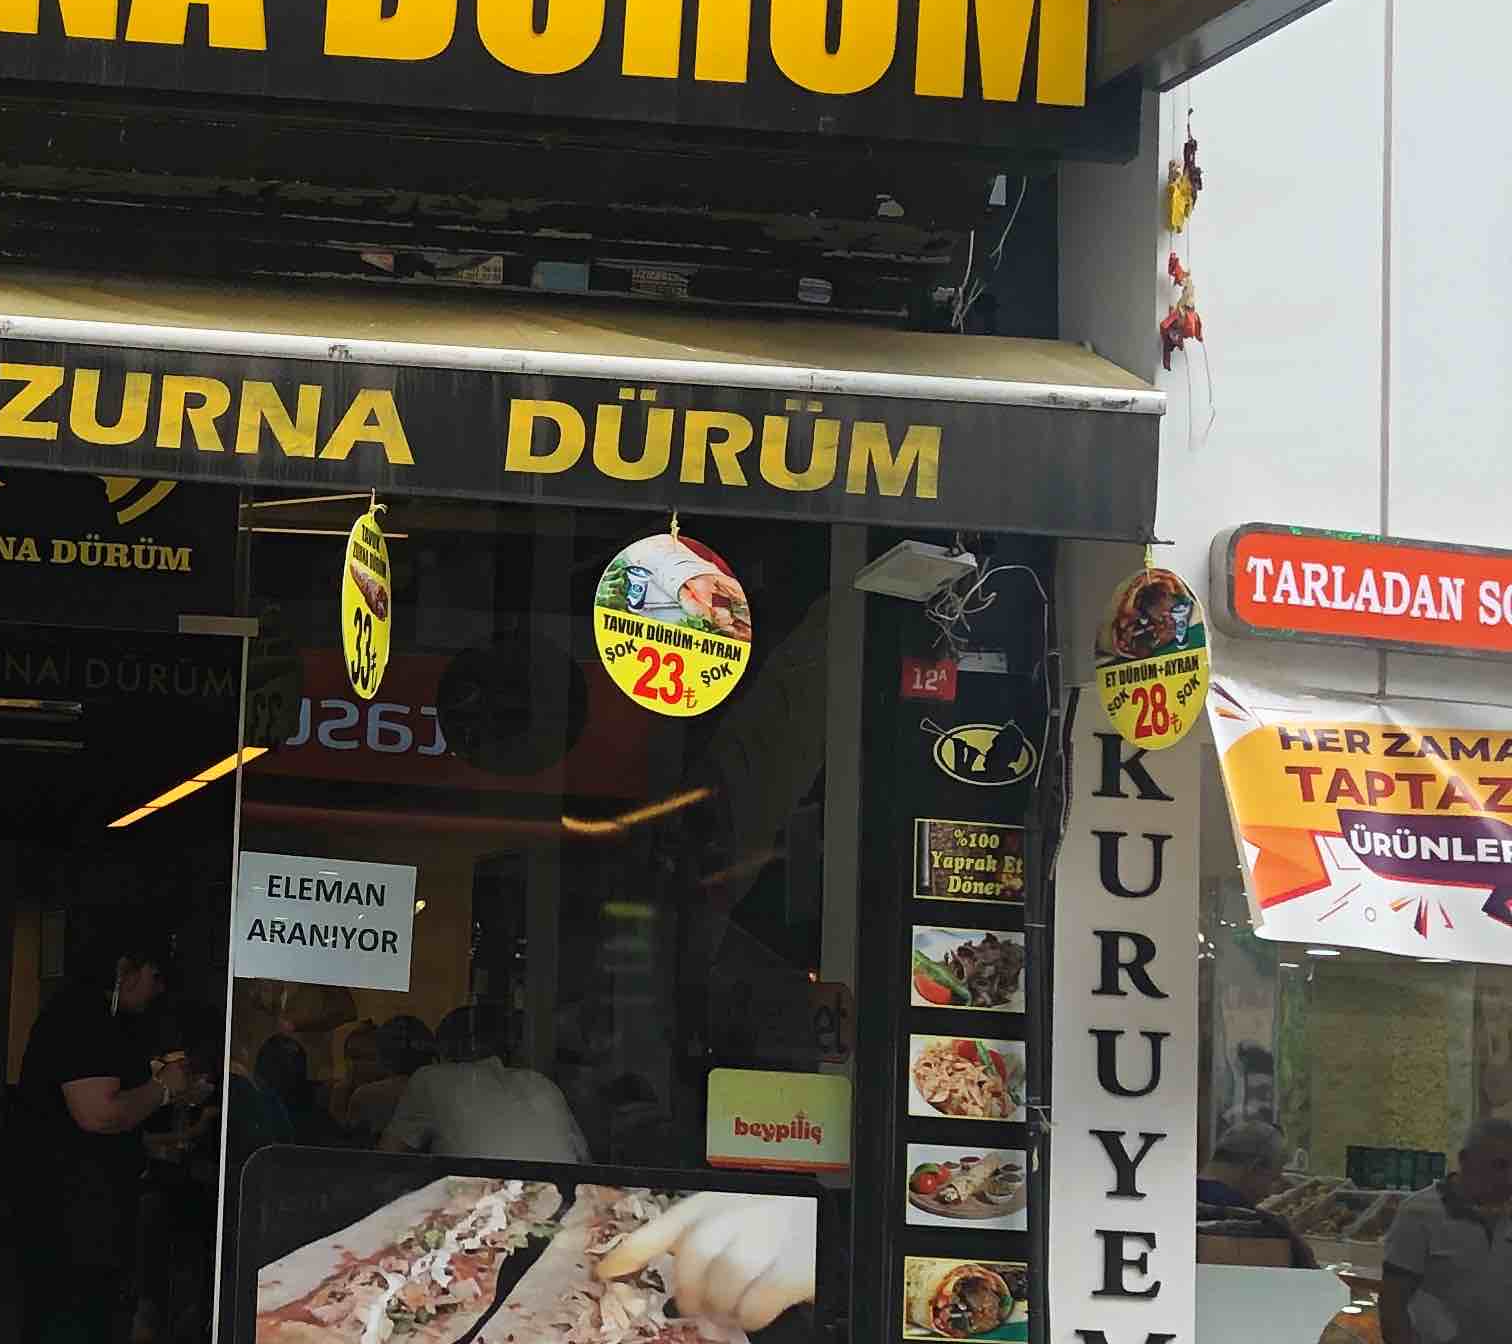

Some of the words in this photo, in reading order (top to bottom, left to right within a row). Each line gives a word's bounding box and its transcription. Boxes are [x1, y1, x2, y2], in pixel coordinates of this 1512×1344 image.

[504, 387, 943, 500] DÜRÜM
[50, 533, 191, 573] DÜRÜM
[1246, 556, 1464, 622] TARLADAN
[602, 614, 645, 638] TAVUK
[604, 639, 638, 665] ŞOK
[701, 662, 733, 688] ŞOK
[1107, 687, 1130, 716] ŞOK
[1176, 673, 1200, 706] ŞOK
[1278, 726, 1370, 753] HER
[953, 828, 1000, 848] %100
[931, 850, 997, 874] Yaprak
[266, 874, 387, 908] ELEMAN
[247, 918, 399, 955] ARANIYOR
